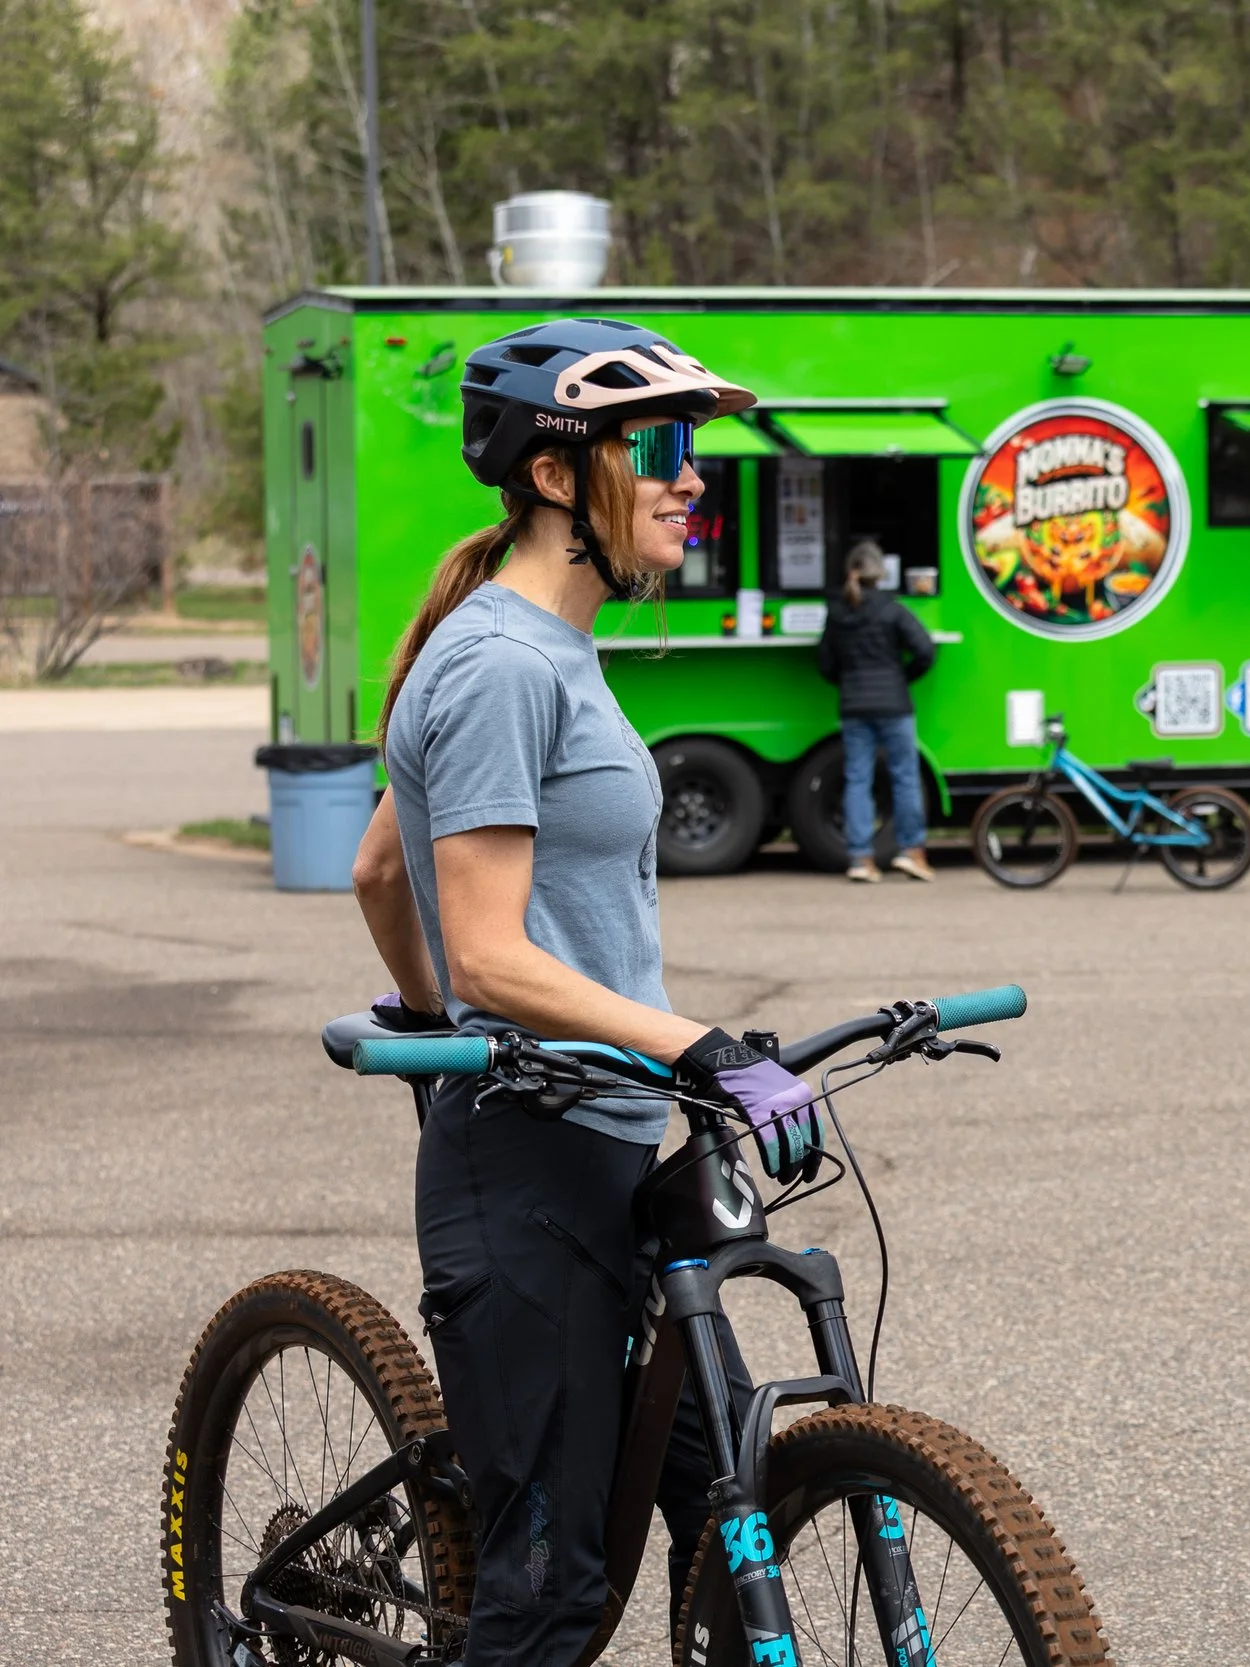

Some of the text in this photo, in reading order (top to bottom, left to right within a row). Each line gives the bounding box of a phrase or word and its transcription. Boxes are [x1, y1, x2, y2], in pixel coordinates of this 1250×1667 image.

[535, 413, 587, 434] SMITH
[1016, 476, 1129, 525] BURRITO
[170, 1448, 188, 1601] MAXXIS
[720, 1511, 774, 1574] 36
[736, 1565, 780, 1586] FACTORY 36
[317, 1633, 376, 1661] INTRIGUE
